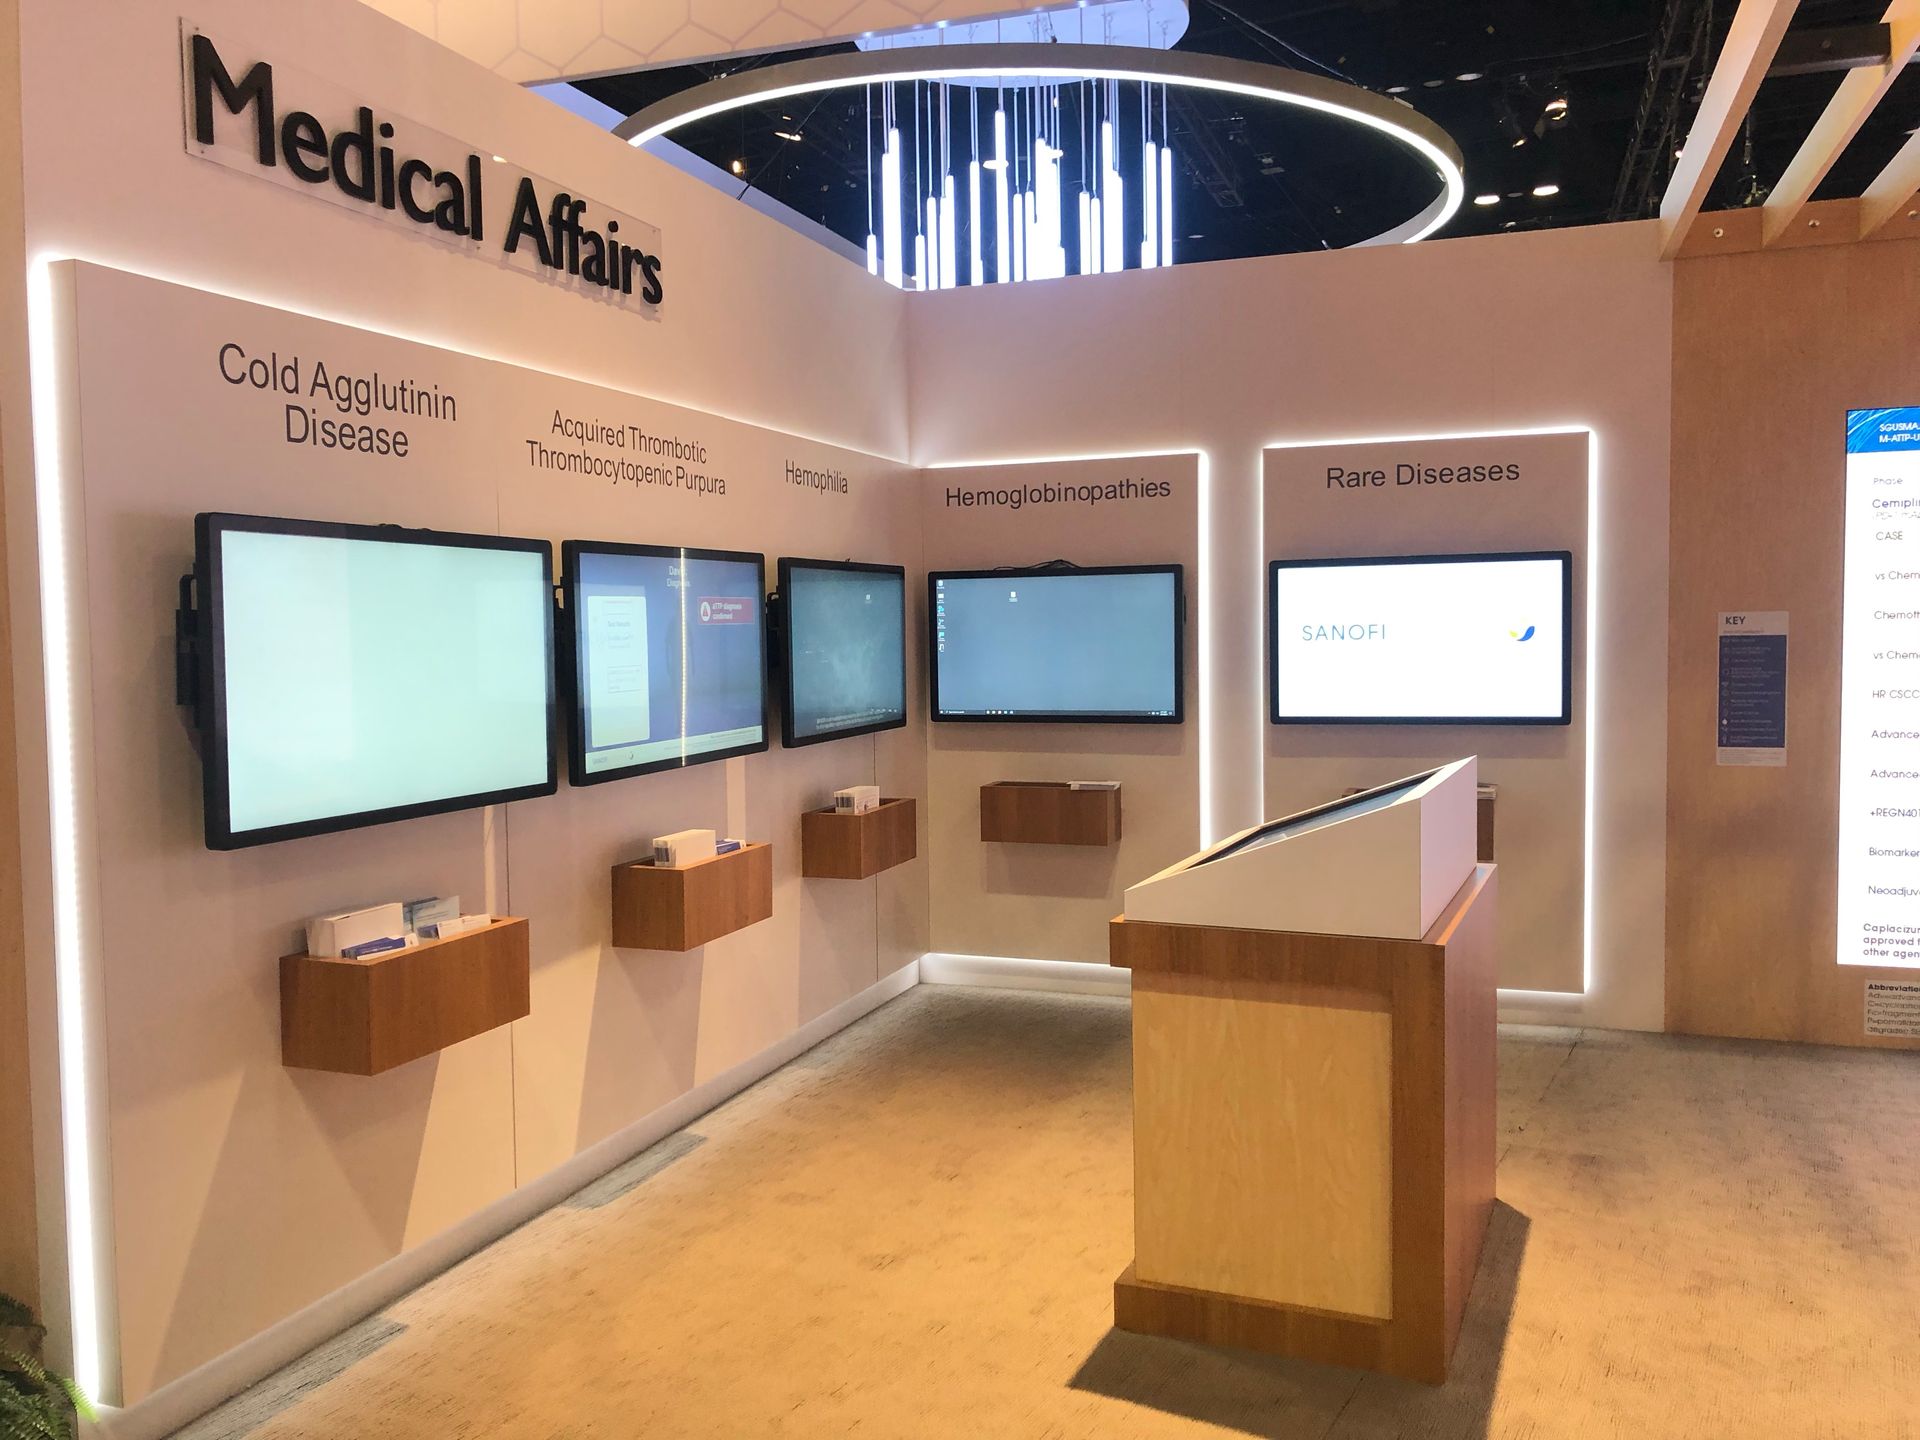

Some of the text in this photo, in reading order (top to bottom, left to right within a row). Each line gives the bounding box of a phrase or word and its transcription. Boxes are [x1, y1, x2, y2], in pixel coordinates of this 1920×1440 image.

[193, 34, 663, 304] Medical Affairs
[219, 343, 457, 421] Cold Agglutinin
[286, 404, 409, 458] Disease
[552, 410, 708, 465] Acquired Thrombotic
[526, 440, 727, 497] Thrombocytopenic Purpura
[785, 459, 848, 495] Hemophilia
[1326, 463, 1520, 489] Rare Diseases
[945, 478, 1172, 509] Hemoglobinopathies
[1875, 530, 1903, 541] CASE
[1302, 624, 1385, 641] SANOFI
[1725, 616, 1746, 625] KEY
[1873, 652, 1884, 660] vs
[1872, 689, 1886, 699] HR
[1863, 936, 1914, 946] approved
[1863, 948, 1889, 957] other
